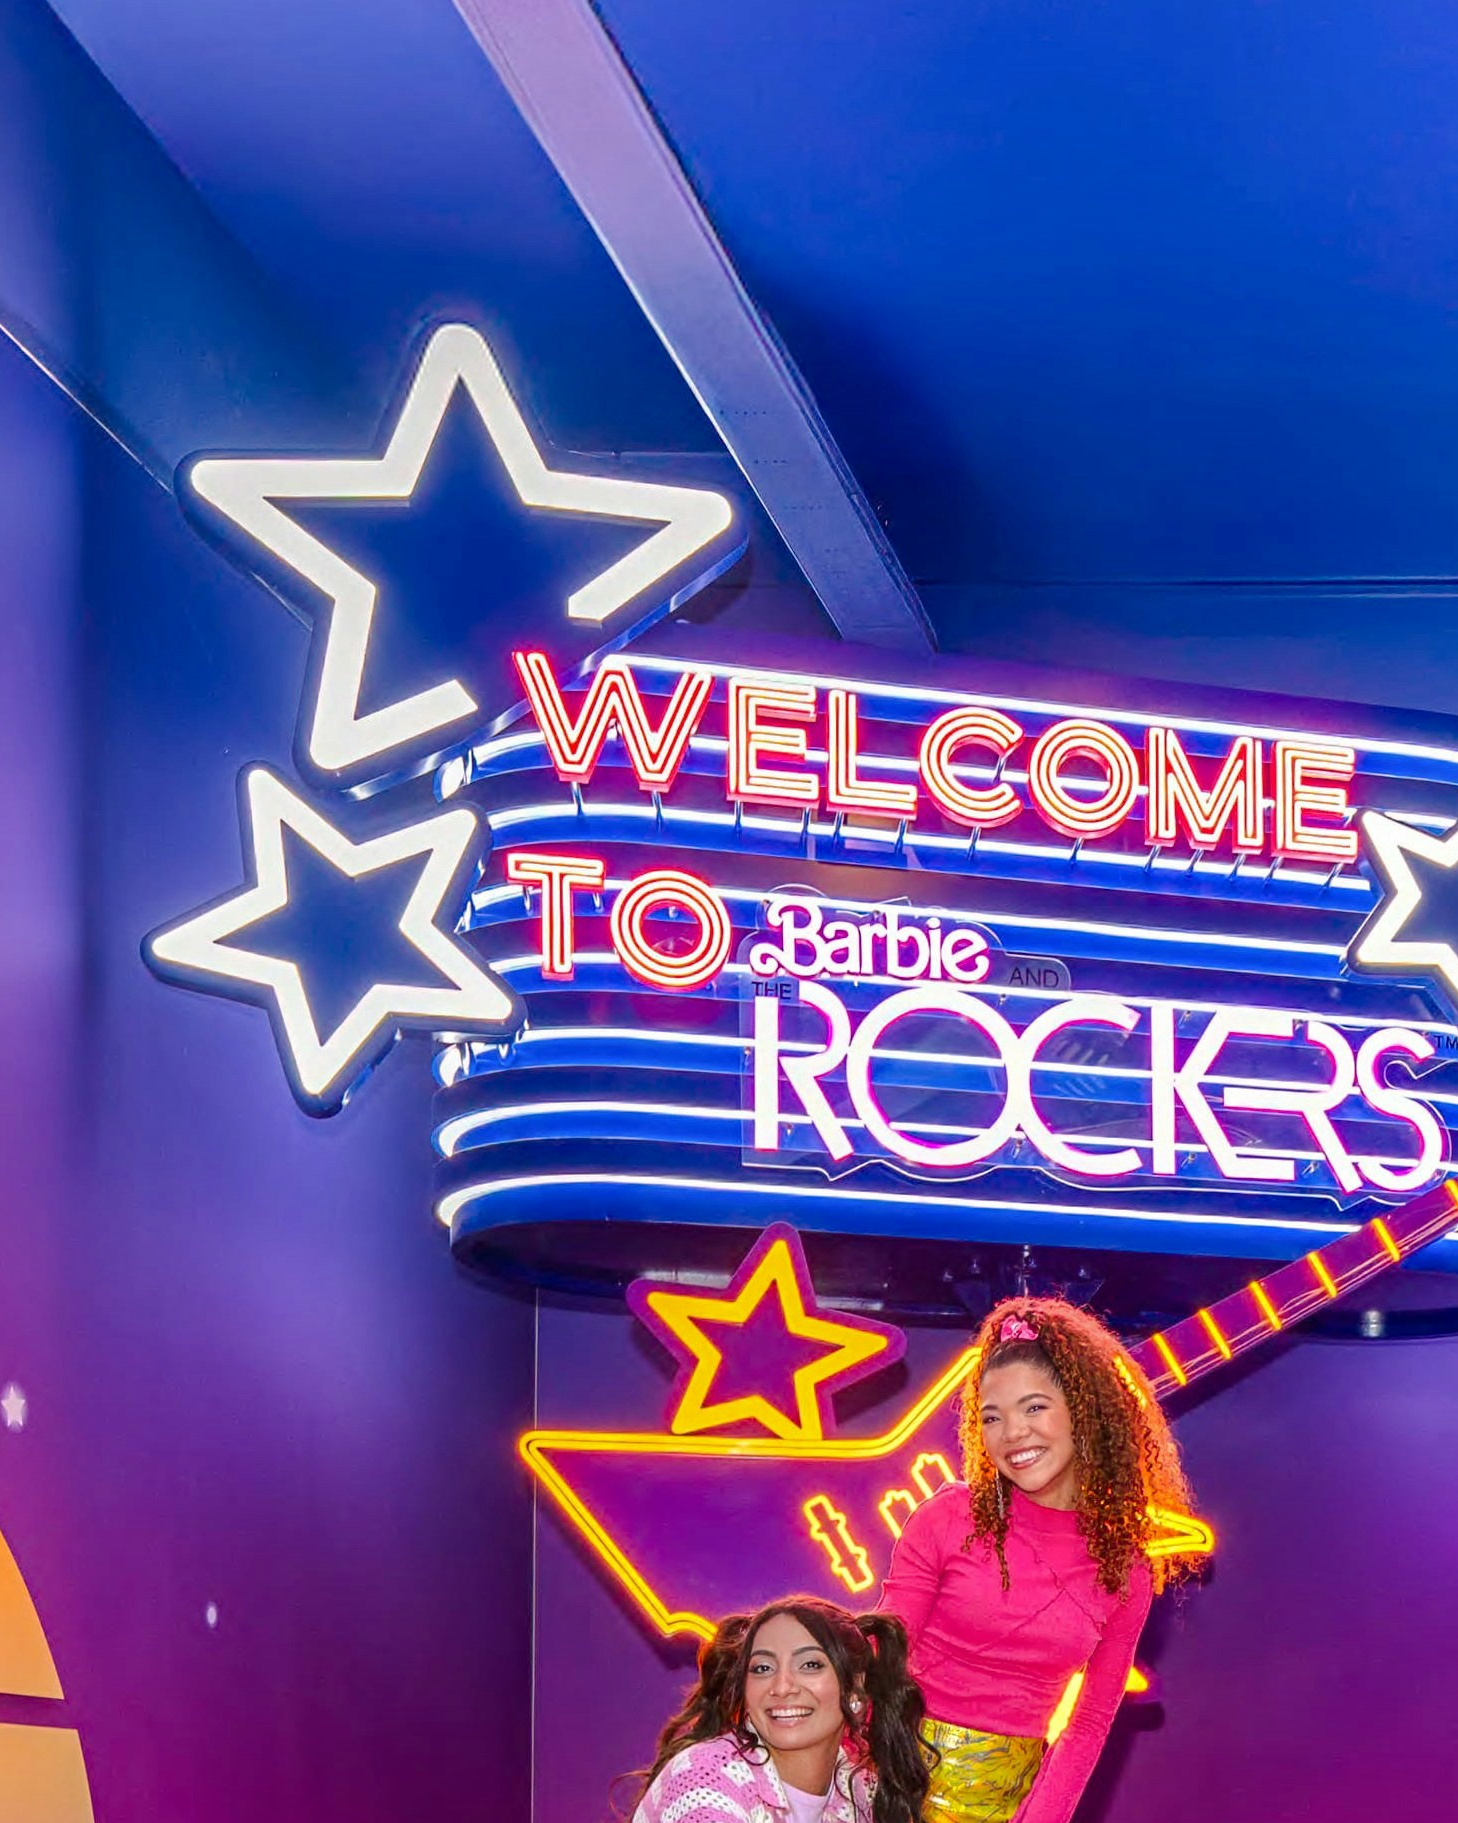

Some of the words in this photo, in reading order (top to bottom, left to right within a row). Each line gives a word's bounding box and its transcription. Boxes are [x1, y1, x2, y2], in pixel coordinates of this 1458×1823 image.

[512, 649, 1360, 859] WELCOME
[506, 852, 732, 990] TO
[749, 898, 990, 983] Barbie
[1008, 966, 1060, 990] AND
[751, 980, 792, 1001] THE
[752, 989, 1450, 1196] ROCKERS
